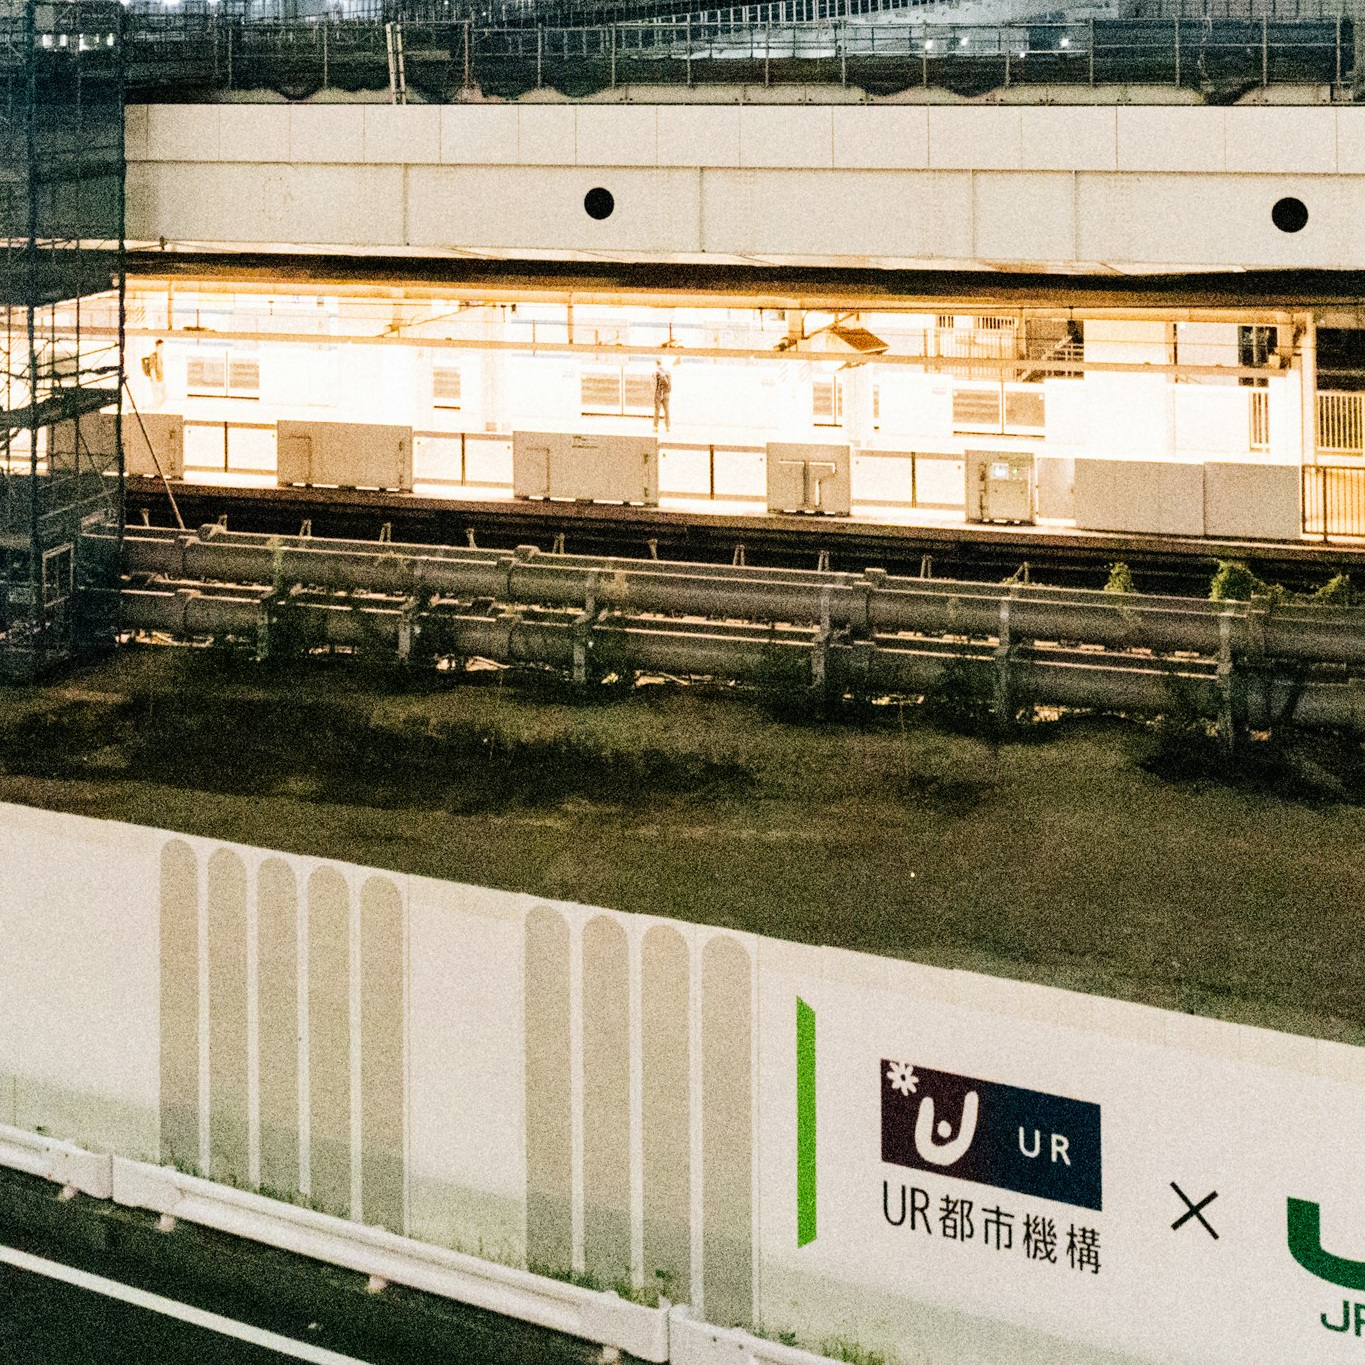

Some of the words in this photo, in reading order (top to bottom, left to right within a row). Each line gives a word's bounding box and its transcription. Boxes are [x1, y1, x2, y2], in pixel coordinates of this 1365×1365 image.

[1018, 1126, 1072, 1166] UR
[882, 1179, 1102, 1275] UR都市機構
